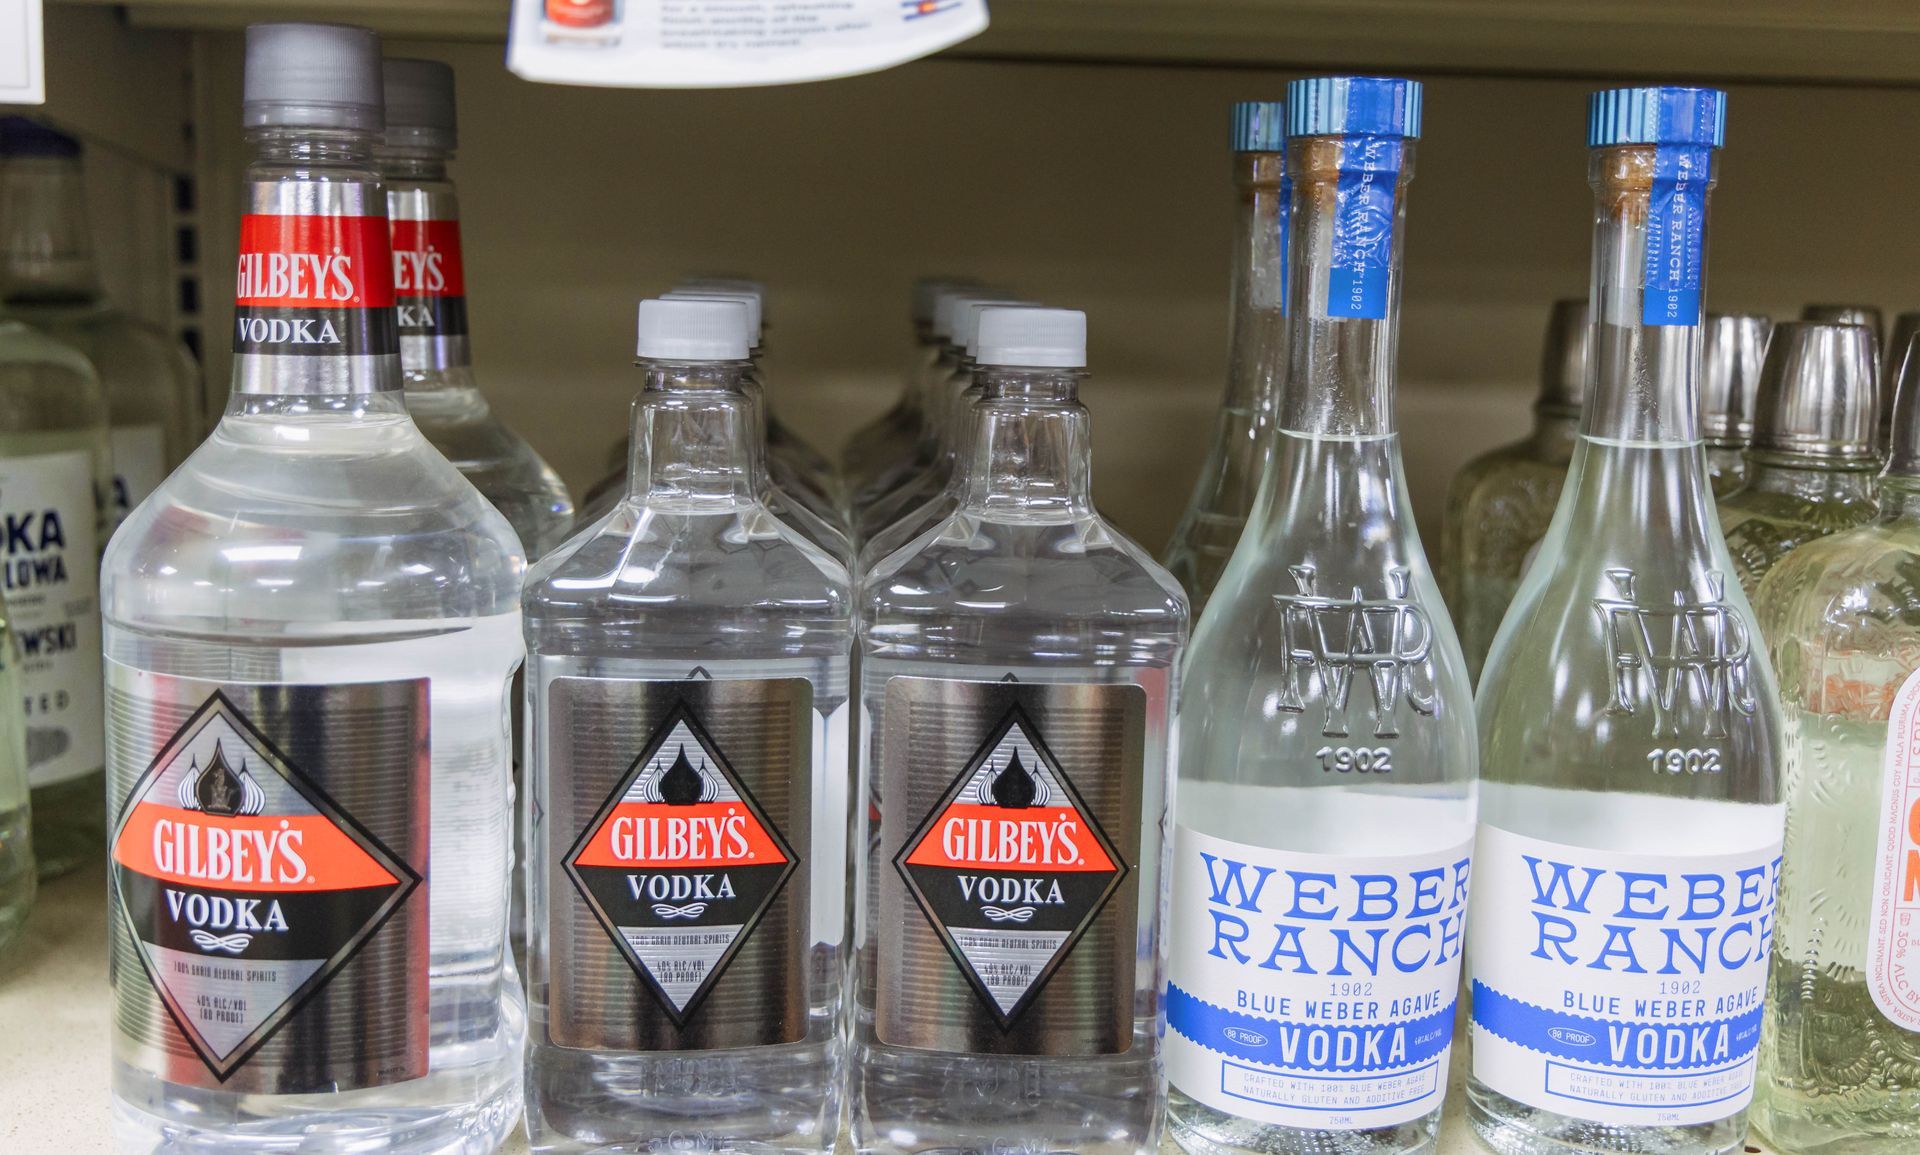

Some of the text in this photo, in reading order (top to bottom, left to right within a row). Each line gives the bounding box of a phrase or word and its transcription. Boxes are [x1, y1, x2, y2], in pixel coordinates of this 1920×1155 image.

[1359, 144, 1376, 206] WEBER
[1666, 153, 1689, 318] WEBER RANCH 1902
[237, 246, 355, 301] GILBEY'S
[393, 245, 444, 292] EY'S
[1350, 279, 1363, 311] 1902
[239, 317, 341, 344] VODKA
[397, 305, 435, 327] KA
[0, 509, 66, 554] KA
[4, 555, 68, 590] LOWA
[1315, 746, 1392, 774] 1902
[1646, 747, 1723, 775] 1902
[611, 807, 750, 861] GILBEY'S
[942, 812, 1080, 866] GILBEY'S
[153, 819, 308, 885] GILBEY'S
[627, 874, 736, 900] VODKA
[957, 875, 1065, 905] VODKA
[1200, 851, 1471, 922] WEBER
[165, 888, 289, 932] VODKA
[1880, 898, 1889, 917] NON
[703, 934, 730, 944] SPIRITS
[1031, 939, 1057, 949] SPIRITS
[1207, 907, 1465, 977] RANCH
[1529, 907, 1776, 975] RANCH
[1895, 930, 1909, 959] 30%
[246, 970, 277, 982] SPIRITS
[674, 959, 705, 971] ALC/VOL
[1894, 963, 1909, 991] ALC
[1329, 982, 1373, 996] 1902
[1563, 985, 1758, 1018] BLUE WEBER AGAVE
[1659, 980, 1701, 995] 1902
[1237, 989, 1440, 1020] BLUE WEBER AGAVE
[1226, 1029, 1263, 1044] 80 PROOF
[1279, 1026, 1406, 1067] VODKA
[1551, 1029, 1590, 1044] 80 PROOF
[1608, 1023, 1729, 1065] VODKA
[1243, 1085, 1295, 1101] NATURALLY
[1301, 1095, 1338, 1105] GLUTEN
[1343, 1095, 1360, 1105] AND
[1365, 1090, 1405, 1103] ADDITIVE
[1244, 1072, 1285, 1088] CRAFTED
[1290, 1081, 1315, 1092] WITH
[1321, 1083, 1344, 1093] 100%
[1349, 1083, 1372, 1093] BLUE
[1377, 1080, 1402, 1091] WEBER
[1569, 1084, 1624, 1100] NATURALLY
[1630, 1093, 1665, 1103] GLUTEN
[1671, 1092, 1688, 1102] AND
[1570, 1072, 1613, 1087] CRAFTED
[1619, 1080, 1643, 1090] WITH
[1677, 1080, 1698, 1090] BLUE
